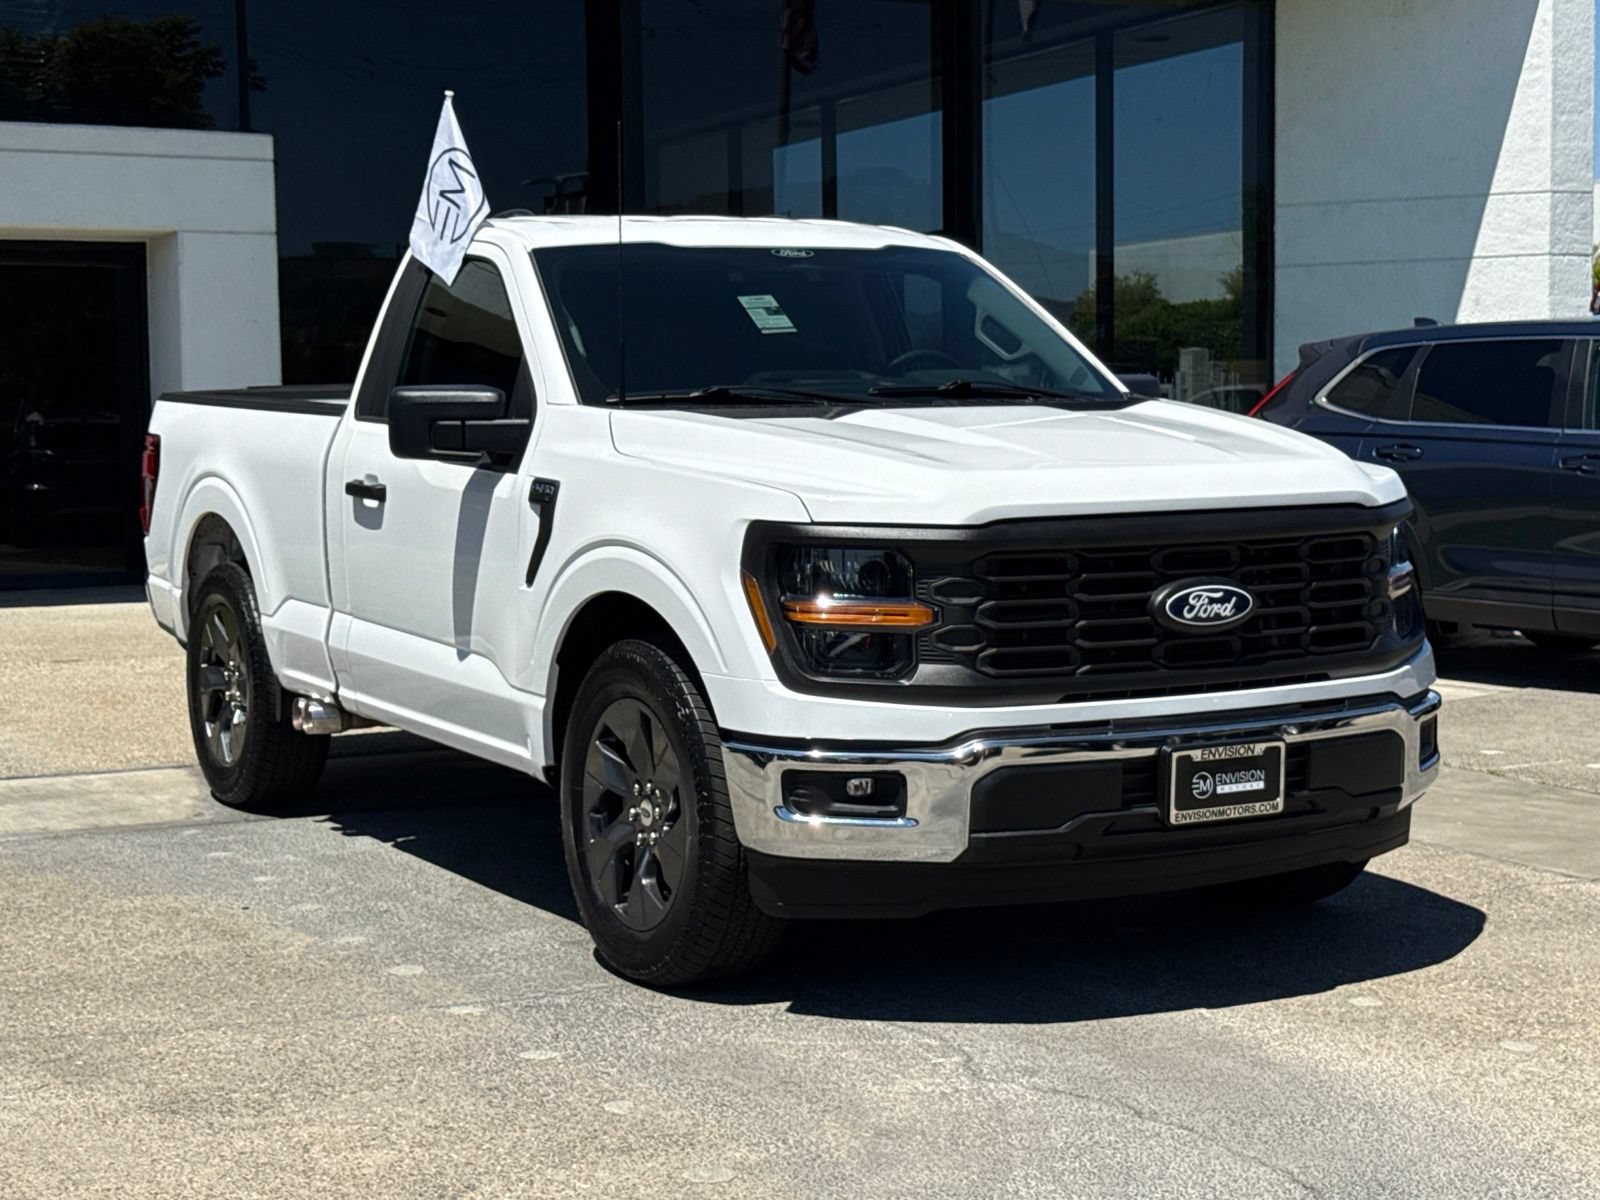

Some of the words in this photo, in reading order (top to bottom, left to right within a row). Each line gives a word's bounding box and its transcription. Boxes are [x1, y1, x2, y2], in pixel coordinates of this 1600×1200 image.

[1183, 591, 1237, 619] Ford
[1200, 745, 1256, 760] ENVISION
[1215, 769, 1265, 785] ENVISION
[1174, 802, 1280, 822] ENVISIONMOTORS.COM
